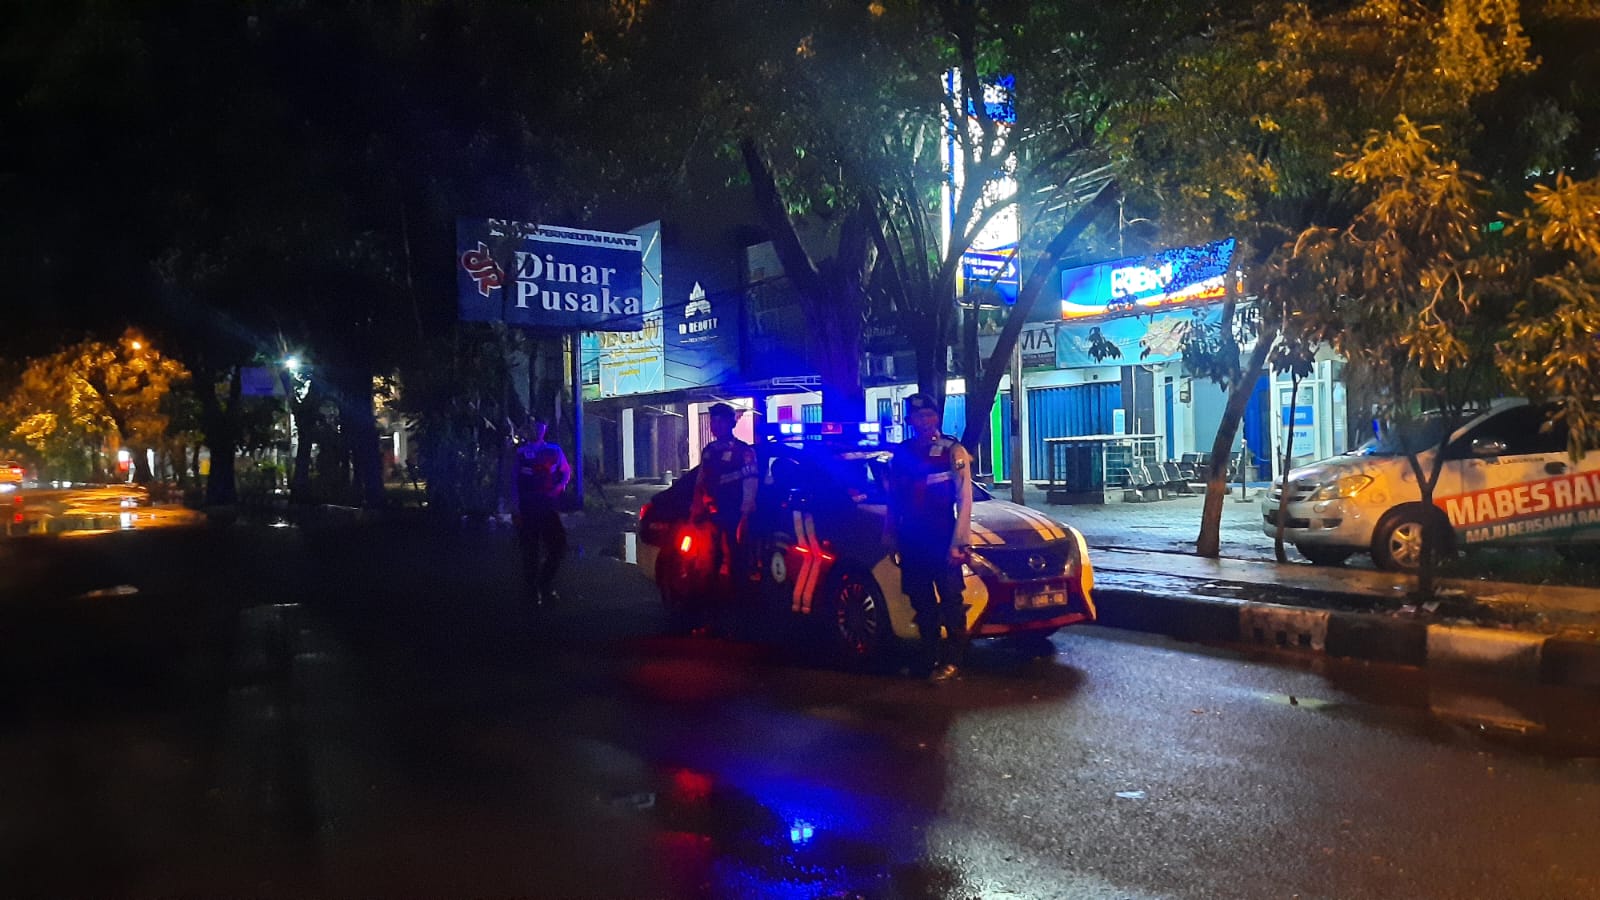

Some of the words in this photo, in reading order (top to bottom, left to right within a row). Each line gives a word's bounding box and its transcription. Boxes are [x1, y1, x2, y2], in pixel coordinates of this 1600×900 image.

[515, 251, 617, 286] Dinar
[515, 281, 640, 315] Pusaka
[688, 318, 718, 333] BEAUTY
[1446, 482, 1549, 526] MABES
[1466, 525, 1507, 544] MAJU
[1508, 512, 1577, 537] BERSAMA
